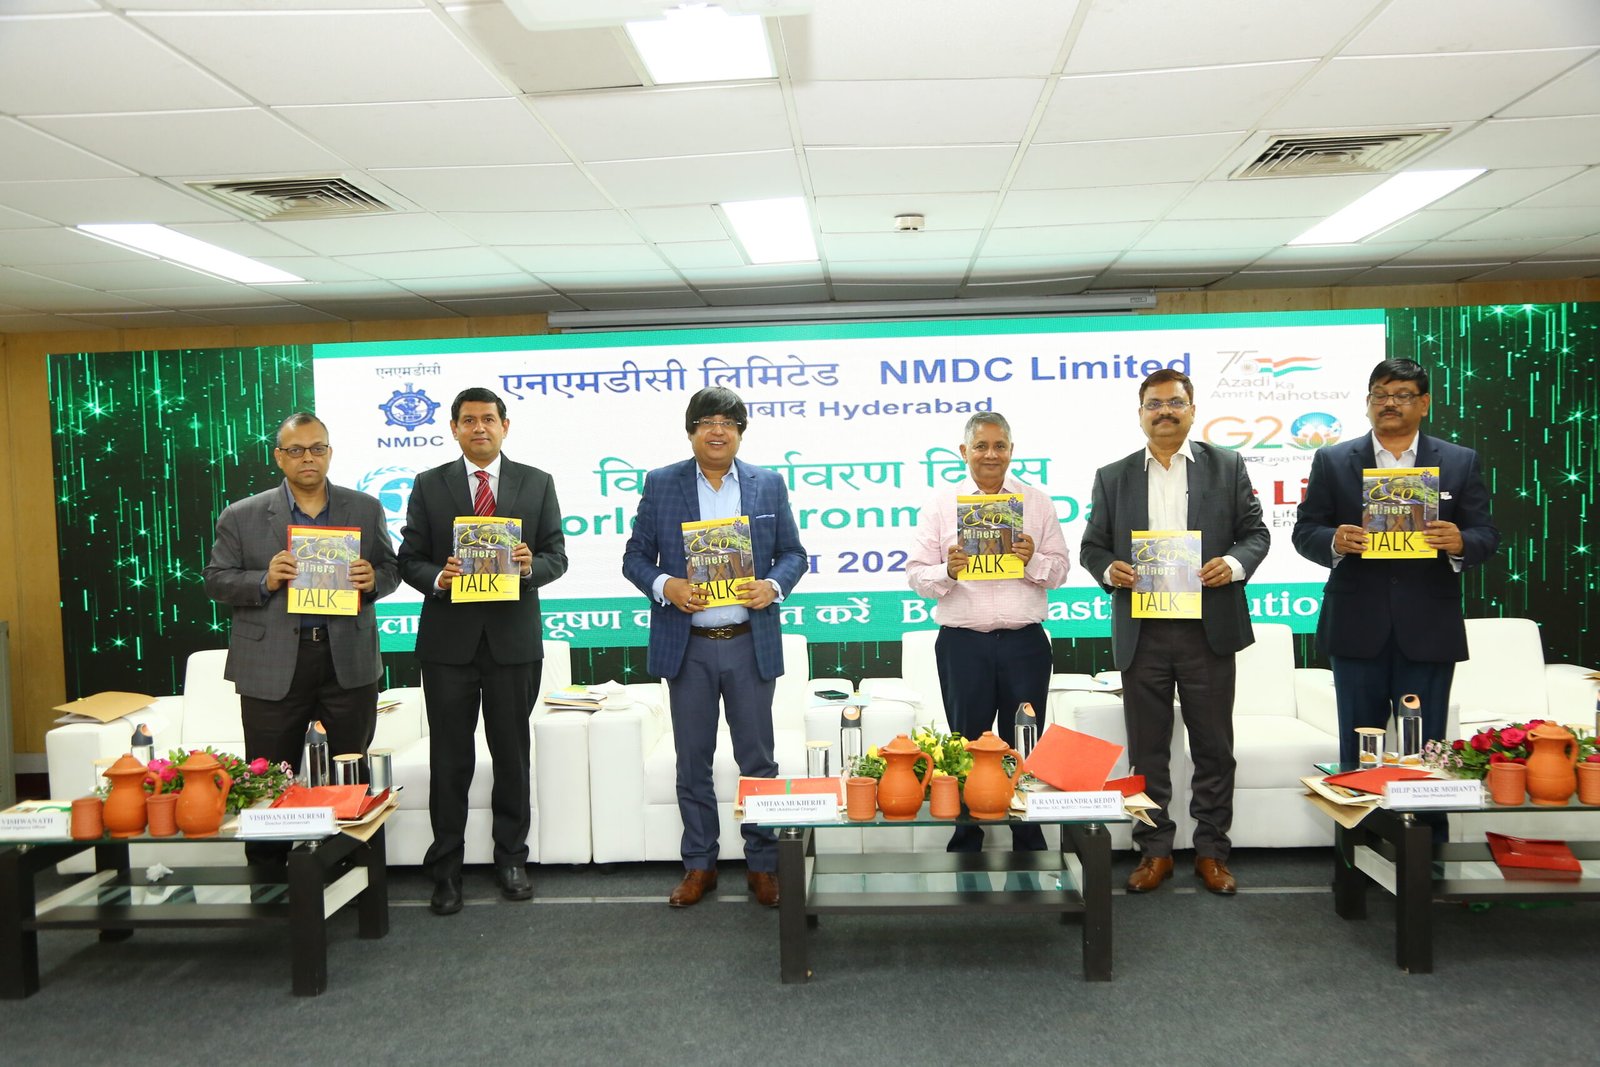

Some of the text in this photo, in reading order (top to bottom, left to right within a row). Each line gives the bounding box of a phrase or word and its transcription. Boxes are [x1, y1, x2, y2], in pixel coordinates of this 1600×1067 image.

[375, 362, 441, 379] एनएमडीसी
[498, 352, 1191, 401] एनएमडीसी लिमिटेड NMDC Limited
[1217, 374, 1296, 390] Azadi Ka
[1210, 389, 1351, 401] Amrit Mahotsav
[818, 396, 993, 421] Hyderabad
[377, 435, 444, 448] NMDC
[1369, 473, 1414, 500] Eco
[963, 500, 1002, 526] Eco
[1369, 504, 1411, 515] Miners
[460, 521, 499, 546] Eco
[690, 526, 729, 553] Eco
[963, 529, 1000, 539] Miners
[1368, 531, 1414, 551] TALK
[297, 535, 338, 559] Eco
[459, 548, 497, 558] Miners
[1137, 537, 1177, 562] Eco
[297, 562, 335, 573] Miners
[691, 554, 729, 567] Miners
[837, 550, 908, 574] 202
[1137, 565, 1176, 575] Miners
[460, 574, 499, 592] TALK
[295, 588, 337, 608] TALK
[1137, 591, 1180, 611] TALK
[1441, 784, 1477, 792] MOHANTY
[1039, 797, 1092, 805] RAMACHANDRA
[249, 813, 296, 821] VISHWANATH
